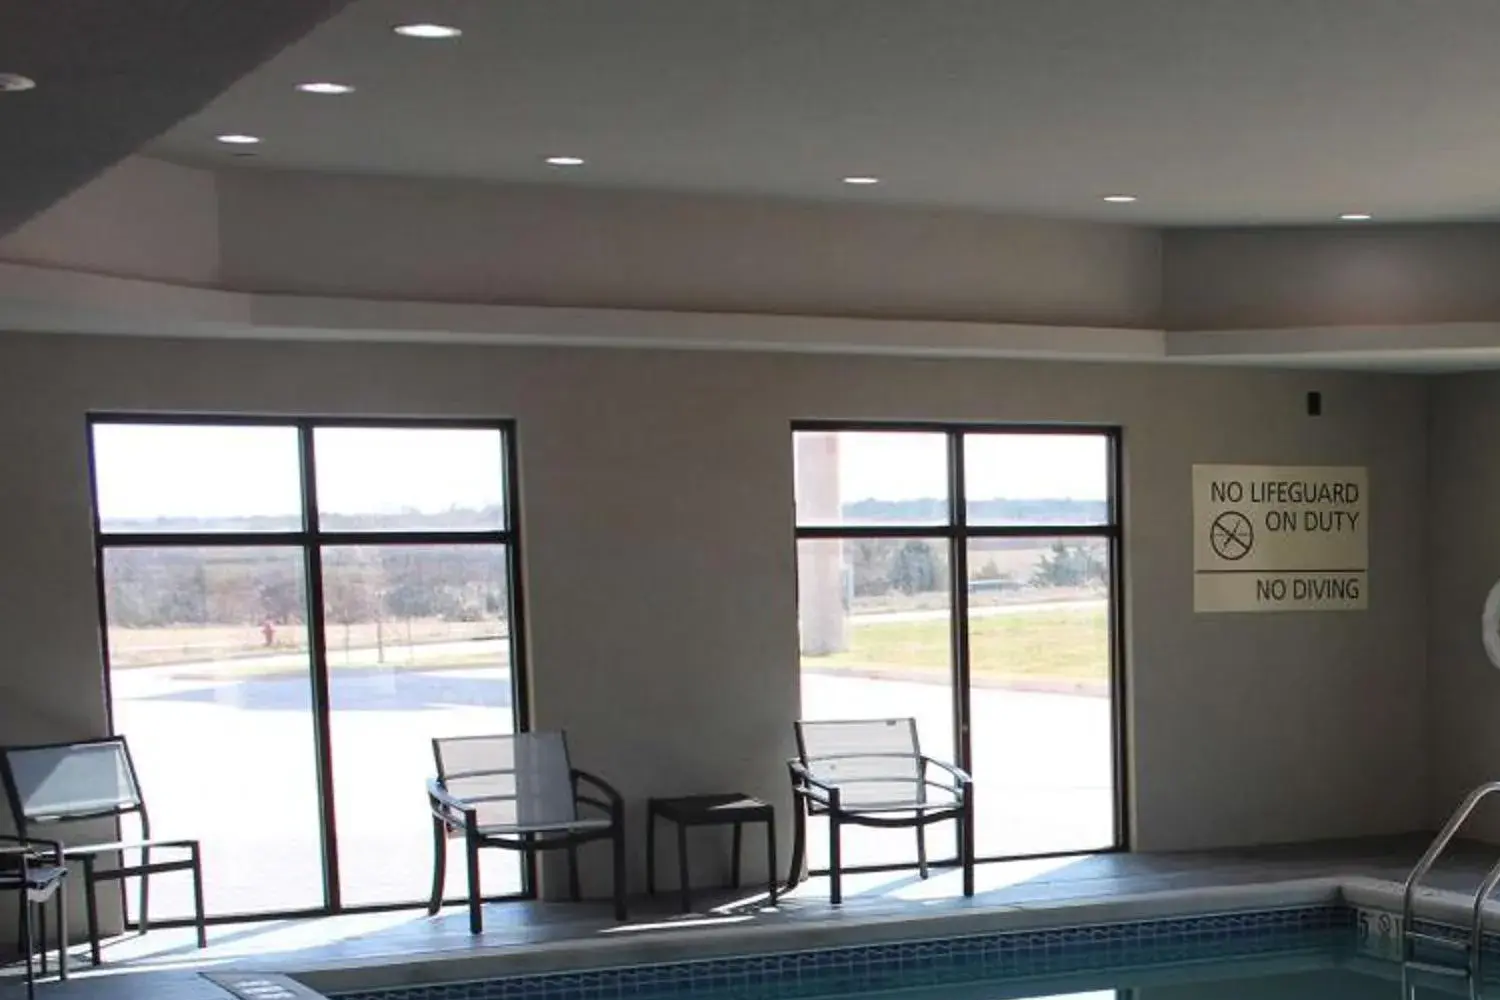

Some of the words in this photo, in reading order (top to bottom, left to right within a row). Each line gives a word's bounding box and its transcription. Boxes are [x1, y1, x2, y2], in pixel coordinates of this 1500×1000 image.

[1211, 481, 1243, 502] NO
[1251, 481, 1359, 503] LIFEGUARD
[1265, 511, 1297, 532] ON
[1304, 511, 1359, 532] DUTY
[1256, 578, 1286, 600] NO
[1293, 578, 1359, 600] DIVING
